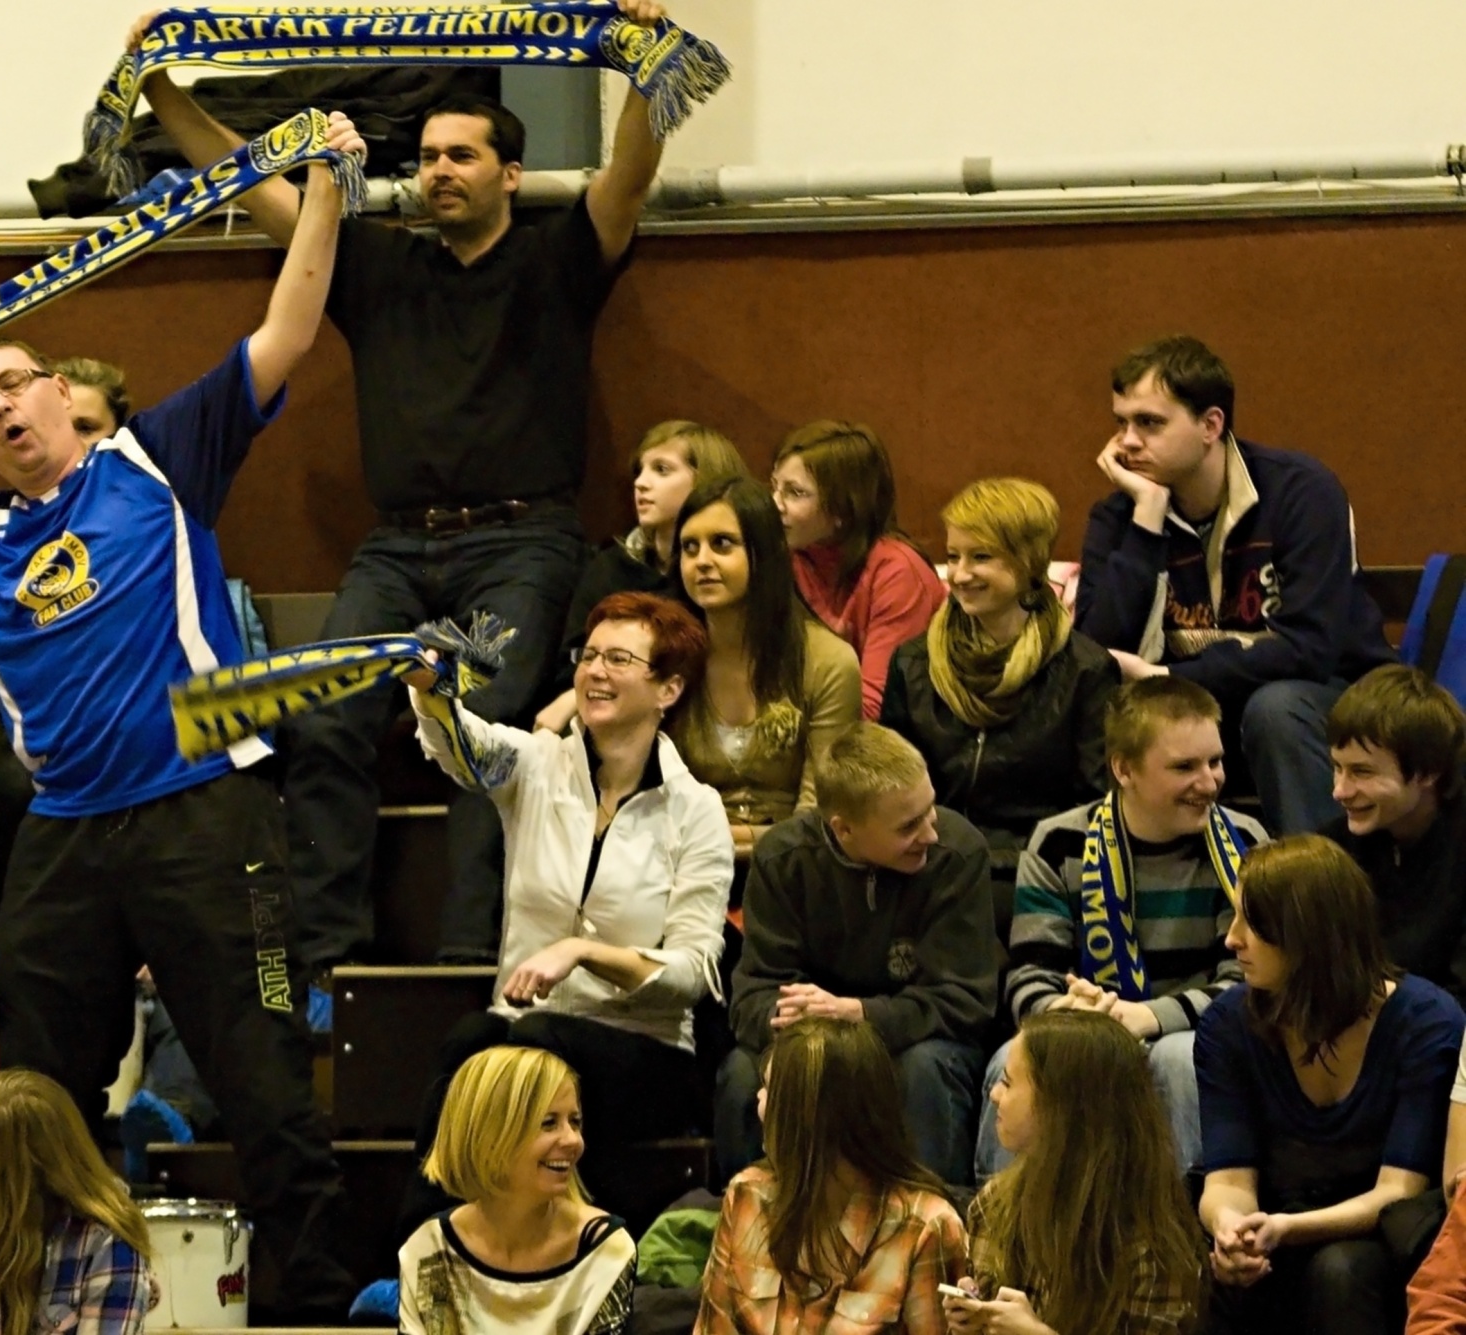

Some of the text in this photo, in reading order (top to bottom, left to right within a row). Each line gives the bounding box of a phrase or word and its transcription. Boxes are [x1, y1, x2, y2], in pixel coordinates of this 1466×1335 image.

[141, 17, 333, 54] SPARTAK
[13, 157, 240, 289] SPARTAK
[37, 583, 93, 625] FAN CLUB
[256, 948, 293, 1014] ATH
